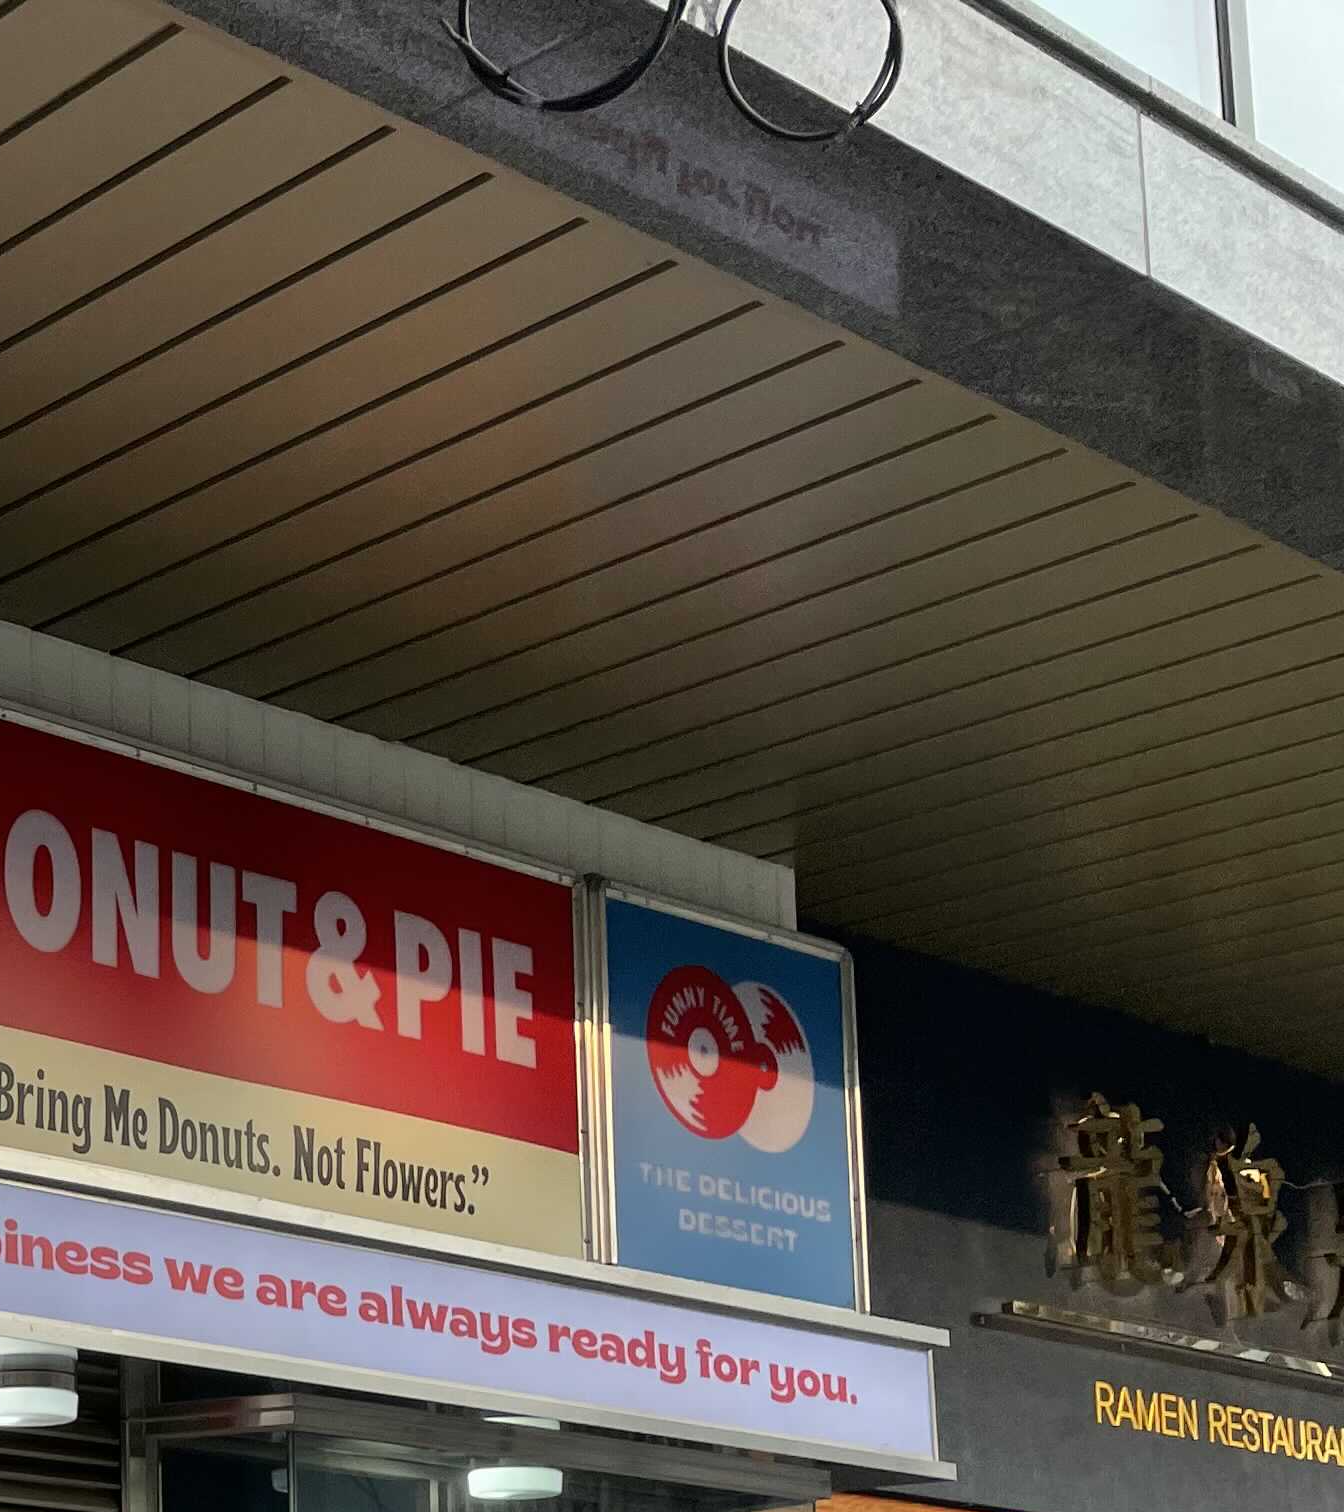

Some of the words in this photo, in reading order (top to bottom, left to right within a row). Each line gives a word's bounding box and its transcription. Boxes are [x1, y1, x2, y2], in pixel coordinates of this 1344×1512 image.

[661, 984, 706, 1038] FUNNY
[711, 995, 745, 1053] TIME
[102, 1083, 150, 1153] Me
[157, 1098, 282, 1179] Donuts.
[293, 1126, 347, 1191] Not
[640, 1161, 692, 1193] THE
[699, 1174, 833, 1223] DELICIOUS
[1058, 1092, 1344, 1332] 龍泉
[678, 1207, 799, 1251] DESSERT
[163, 1256, 246, 1301] we
[255, 1271, 348, 1318] are
[358, 1285, 538, 1355] always
[547, 1323, 688, 1384] ready
[695, 1337, 760, 1386] for
[768, 1362, 859, 1406] you.
[1094, 1380, 1199, 1441] RAMEN
